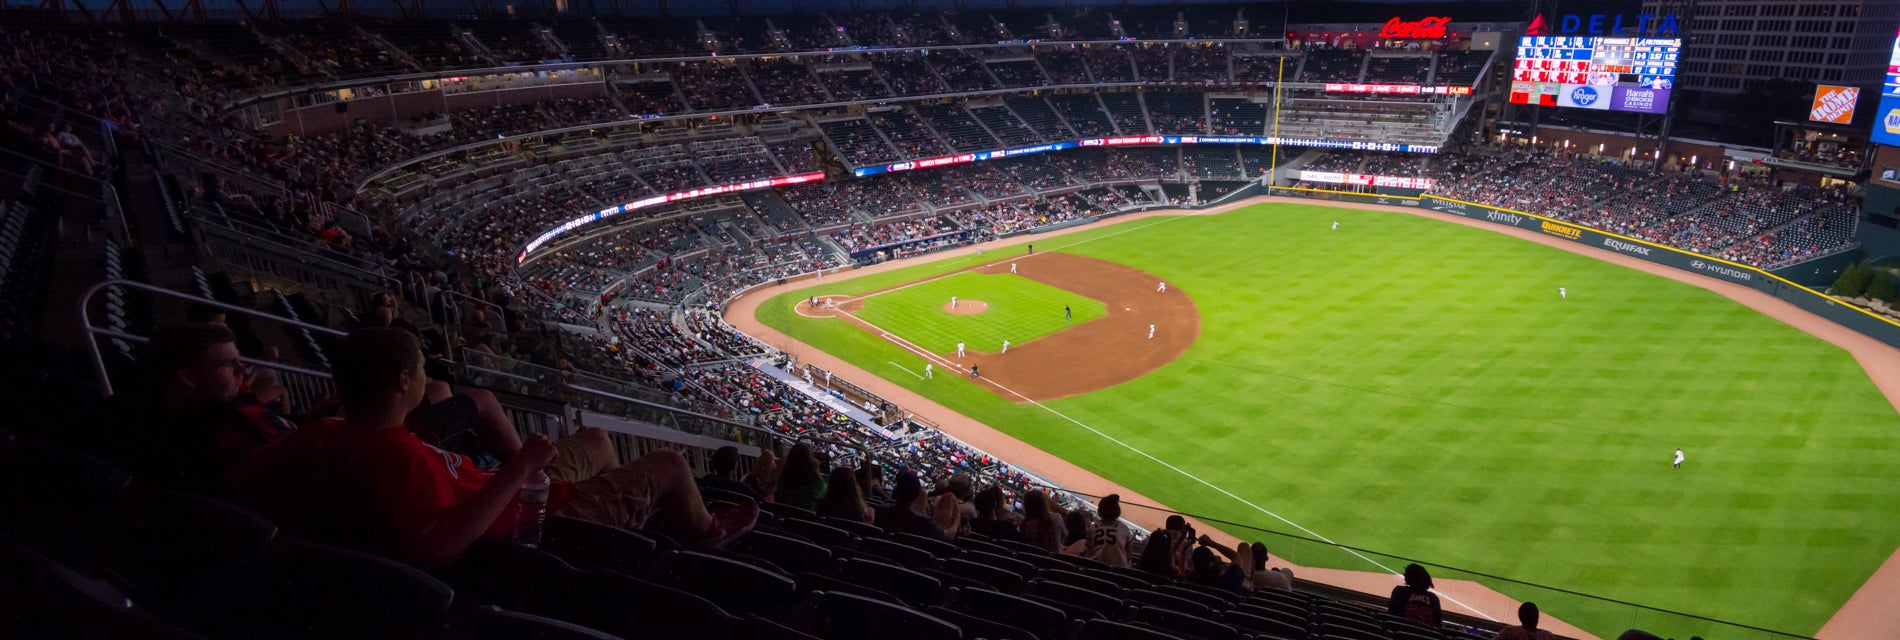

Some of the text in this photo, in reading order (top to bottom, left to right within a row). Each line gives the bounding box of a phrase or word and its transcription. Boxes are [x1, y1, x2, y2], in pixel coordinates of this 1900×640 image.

[1561, 13, 1680, 35] DELTA
[1522, 37, 1532, 46] NL
[1519, 60, 1528, 69] AL
[1573, 88, 1597, 105] Kroger
[1811, 87, 1858, 121] HOME
[1818, 89, 1838, 104] THE
[1825, 100, 1856, 122] DEPOT
[1432, 199, 1466, 210] WELLSTAR
[1487, 210, 1522, 226] xfinity
[1541, 220, 1582, 238] QUIKRETE
[1603, 237, 1650, 256] EQUIFAX
[1707, 264, 1751, 281] HYUNDAI
[1095, 528, 1117, 545] 25
